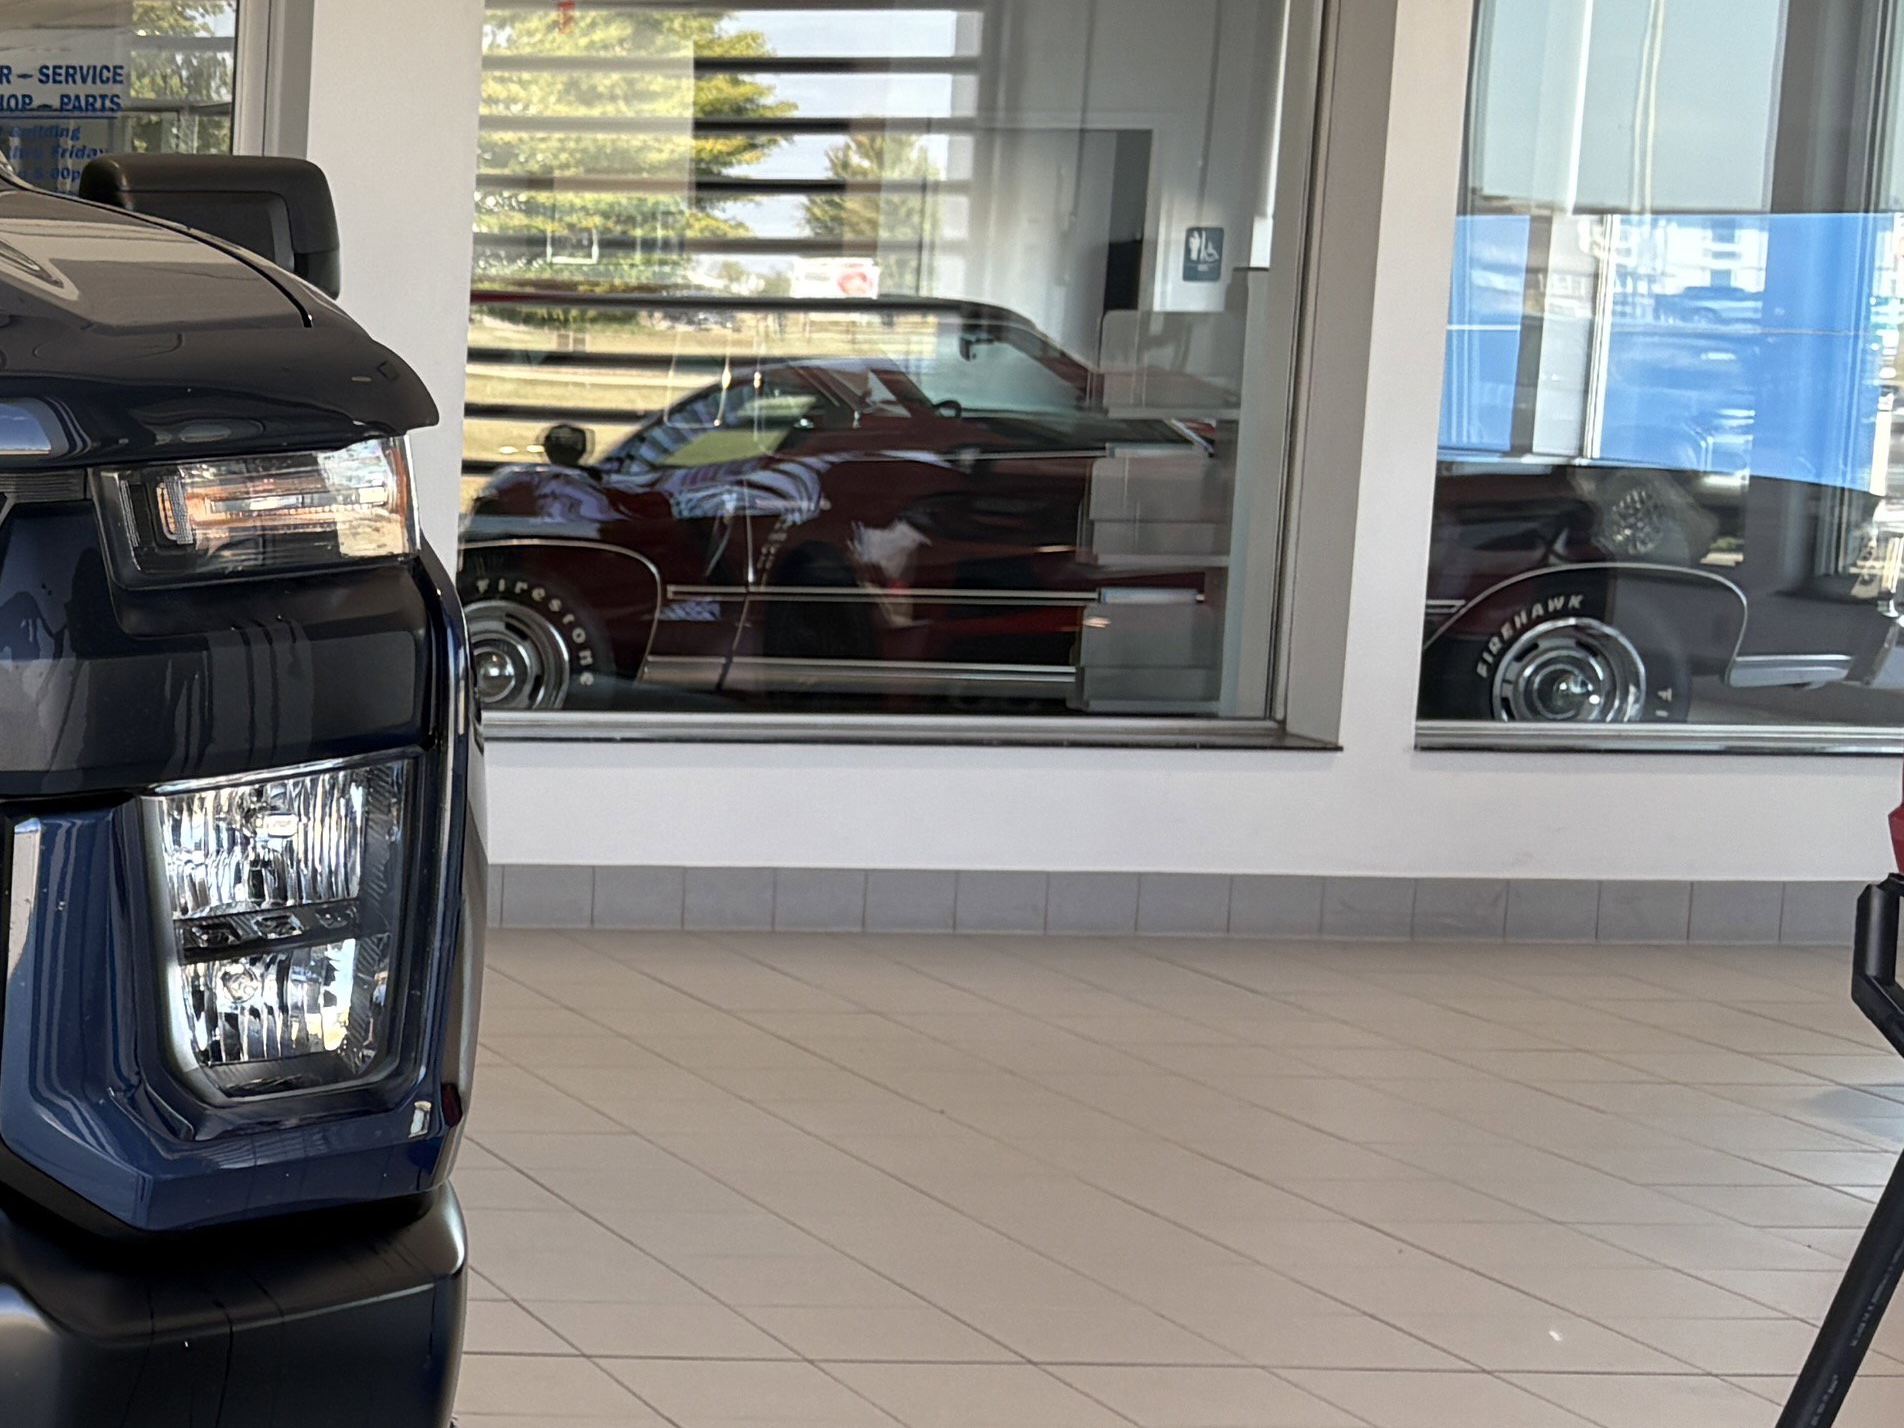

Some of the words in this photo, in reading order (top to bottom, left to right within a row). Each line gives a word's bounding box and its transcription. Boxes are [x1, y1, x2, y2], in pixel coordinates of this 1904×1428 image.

[37, 64, 125, 85] SERVICE
[59, 93, 123, 112] PARTS
[1475, 594, 1585, 679] FIREHAWK
